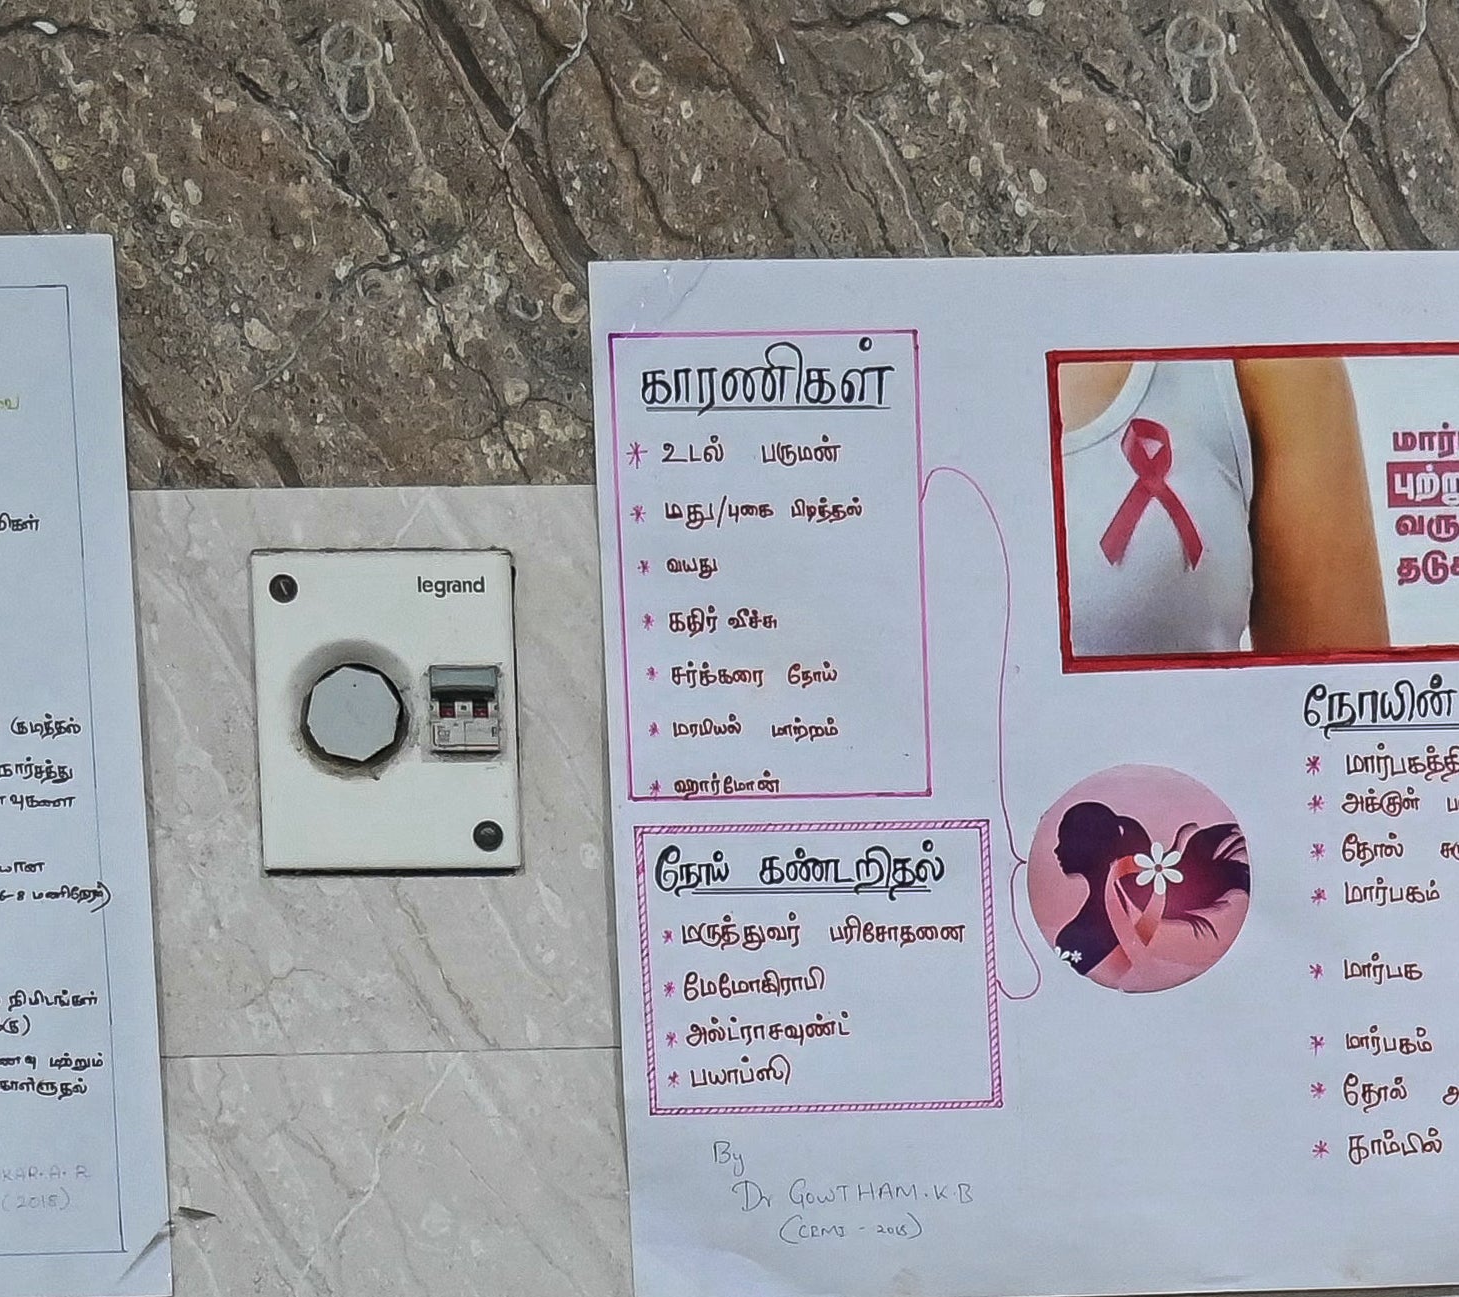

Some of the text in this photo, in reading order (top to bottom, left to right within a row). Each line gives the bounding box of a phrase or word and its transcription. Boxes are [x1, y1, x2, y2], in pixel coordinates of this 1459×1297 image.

[641, 337, 895, 416] காரணிகள்
[661, 434, 842, 467] உடல் பருமன்
[791, 497, 864, 523] பிடித்தல்
[666, 557, 719, 579] வயது
[417, 576, 485, 598] legrand
[668, 605, 778, 637] கதிர் வீச்சு
[671, 661, 838, 688] சர்க்கரை நோய்
[1303, 673, 1458, 739] நோயின்
[10, 713, 82, 738] குடித்தல்
[771, 717, 839, 742] மாற்றம்
[674, 770, 780, 797] ஹார்மோன்
[1341, 786, 1421, 817] அக்குள்
[1341, 831, 1404, 866] தோல்
[654, 839, 947, 901] நோய் கண்டறிதல்
[1344, 876, 1441, 908] மார்பகம்
[681, 911, 801, 951] மருத்துவர்
[683, 966, 826, 1001] மேமோகிராபி
[1344, 952, 1423, 985] மார்பக
[686, 1011, 851, 1047] அல்ட்ராசவுண்ட்
[1345, 1025, 1433, 1056] மார்பகம்
[49, 1052, 104, 1071] மற்றும்
[690, 1054, 792, 1087] பயாப்ஸி
[1343, 1073, 1409, 1113] தோல்
[713, 1141, 744, 1177] By
[1348, 1127, 1442, 1164] காம்பில்
[731, 1180, 772, 1212] Dr
